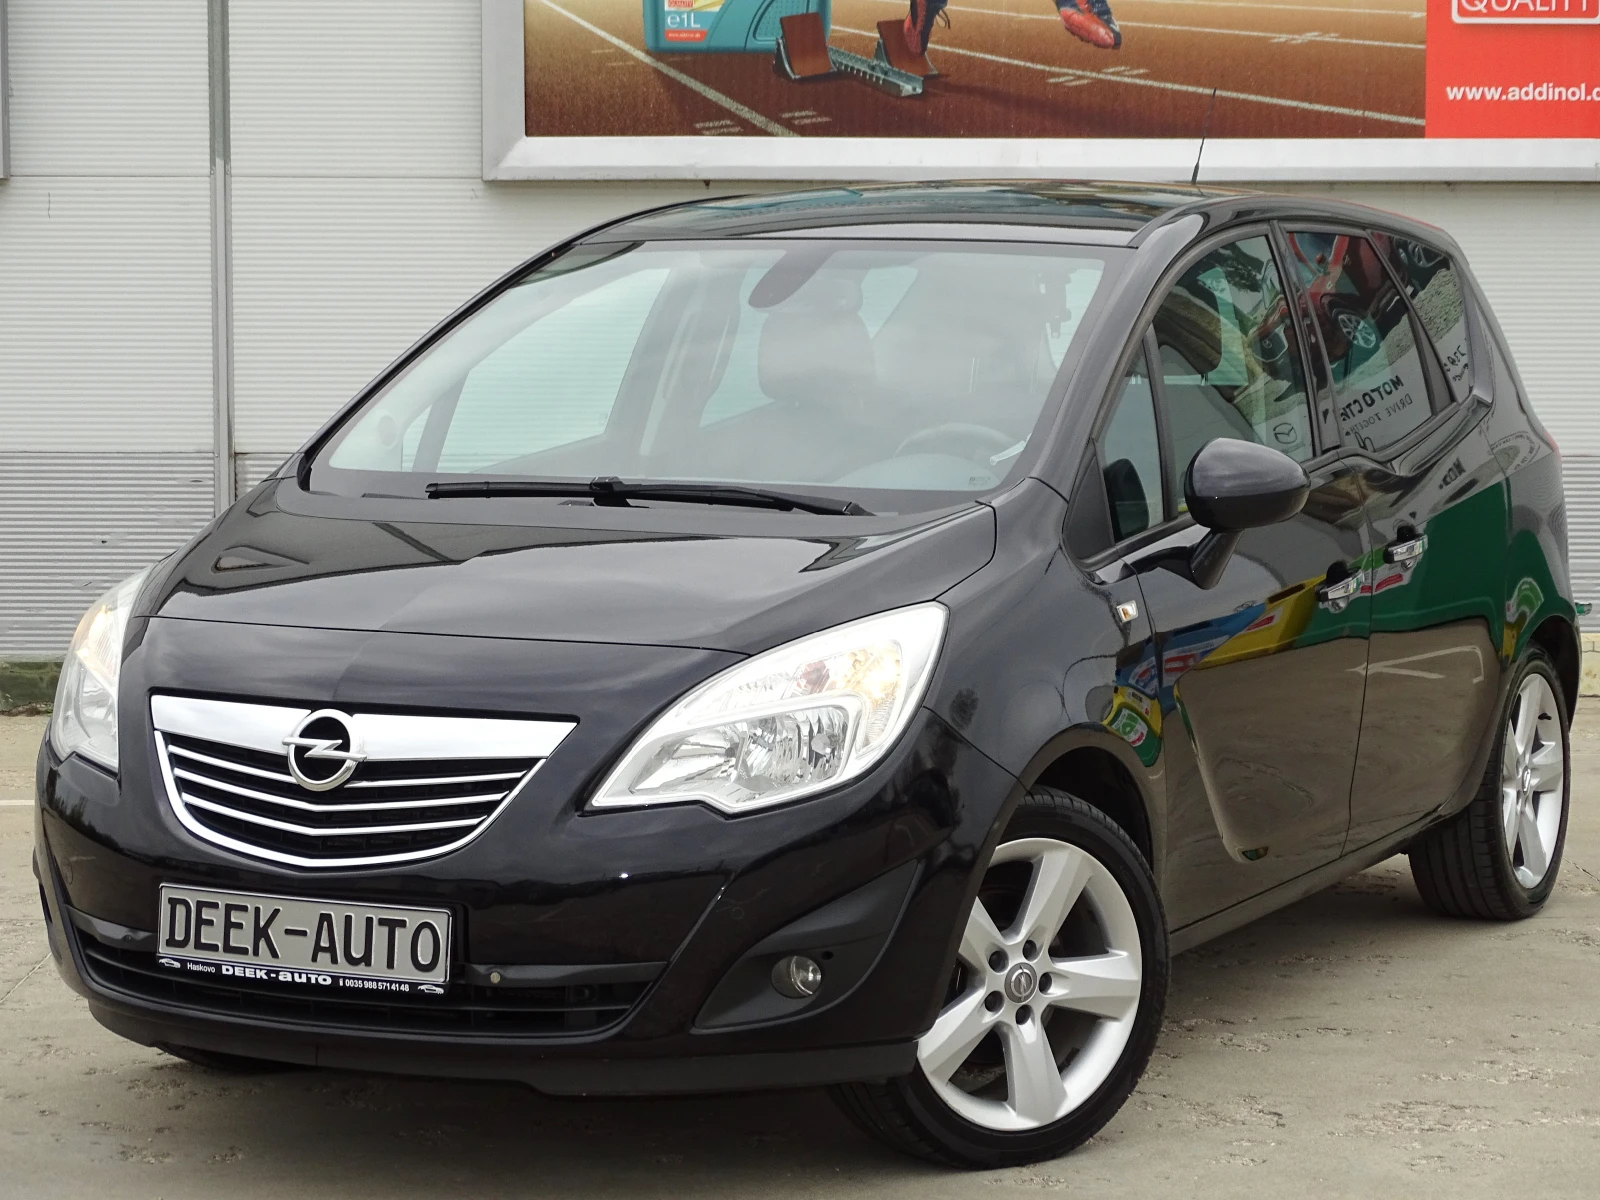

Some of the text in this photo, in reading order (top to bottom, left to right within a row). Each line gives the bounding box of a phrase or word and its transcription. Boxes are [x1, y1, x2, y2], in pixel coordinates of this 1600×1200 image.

[166, 897, 441, 973] DEEK-AUTO
[187, 962, 216, 974] Haskovo
[345, 979, 363, 988] 0035
